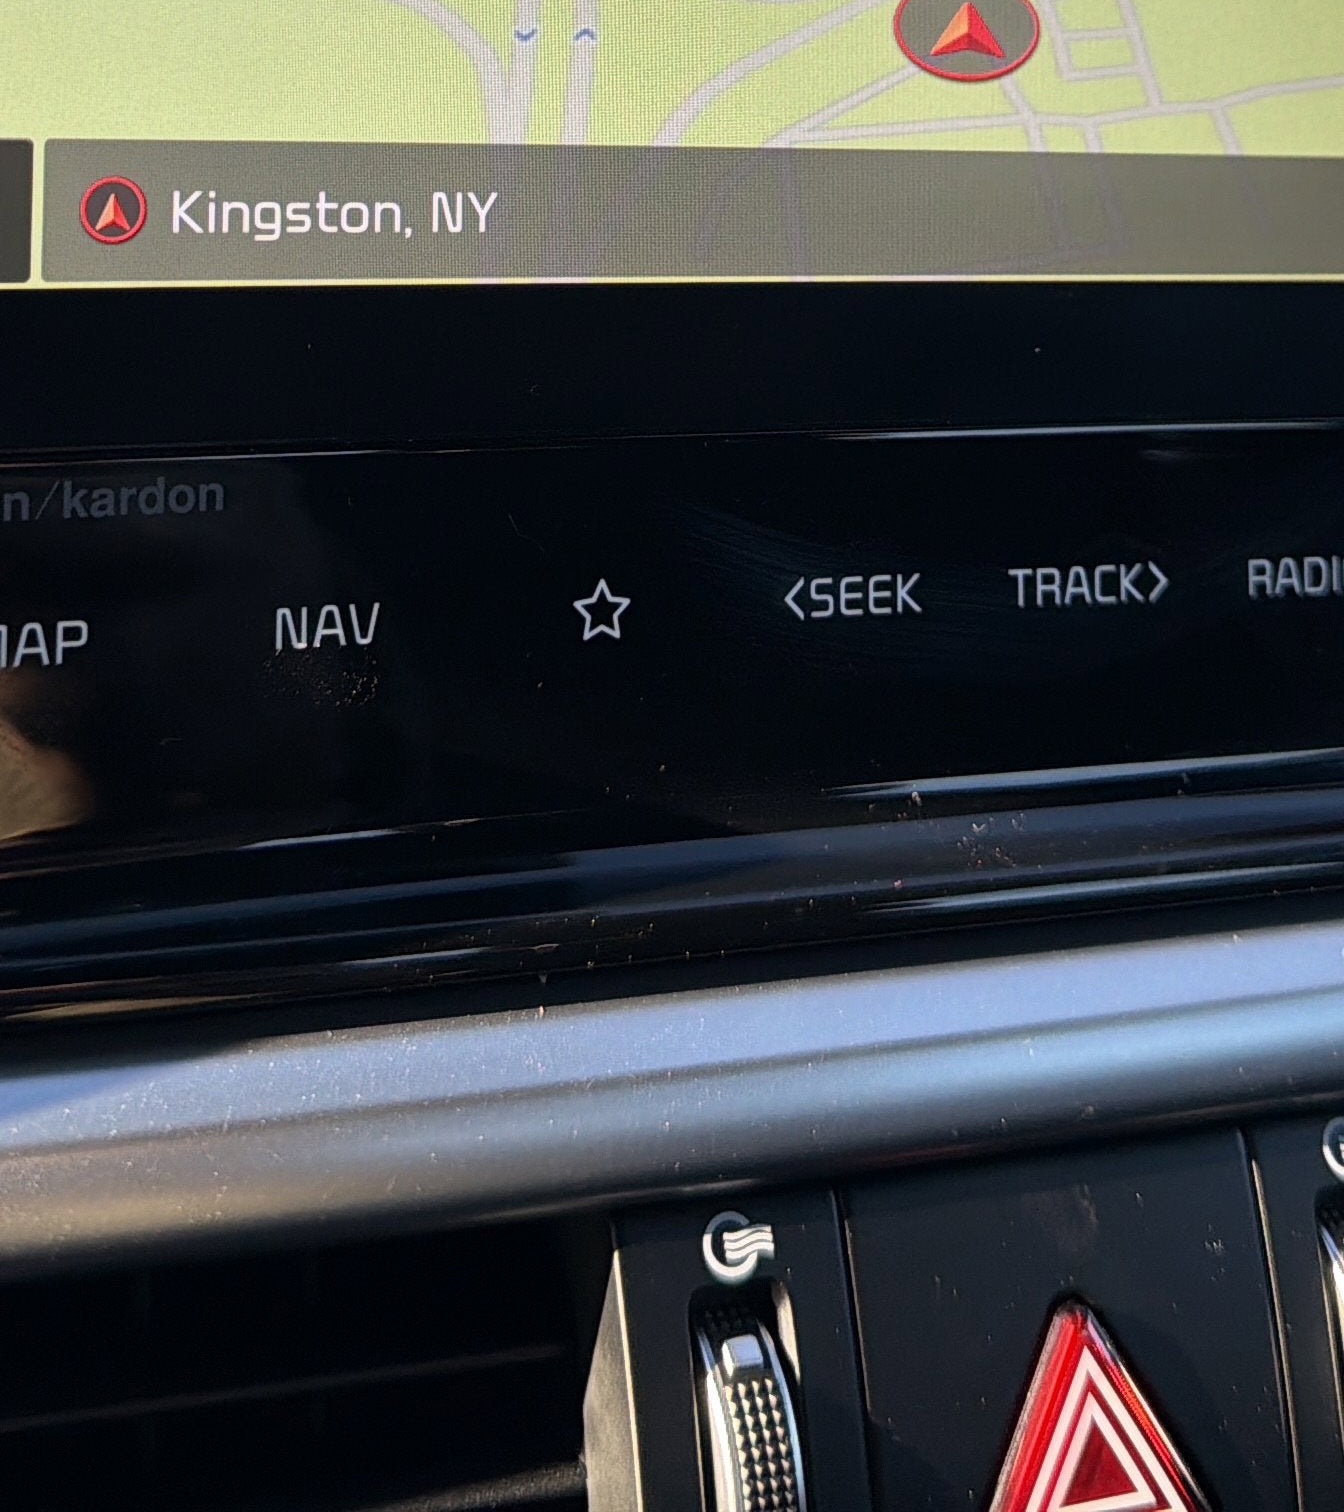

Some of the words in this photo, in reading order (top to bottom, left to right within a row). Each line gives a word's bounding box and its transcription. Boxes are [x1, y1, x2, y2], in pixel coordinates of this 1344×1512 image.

[172, 190, 413, 242] Kingston,
[431, 191, 498, 233] NY
[274, 602, 381, 651] NAV
